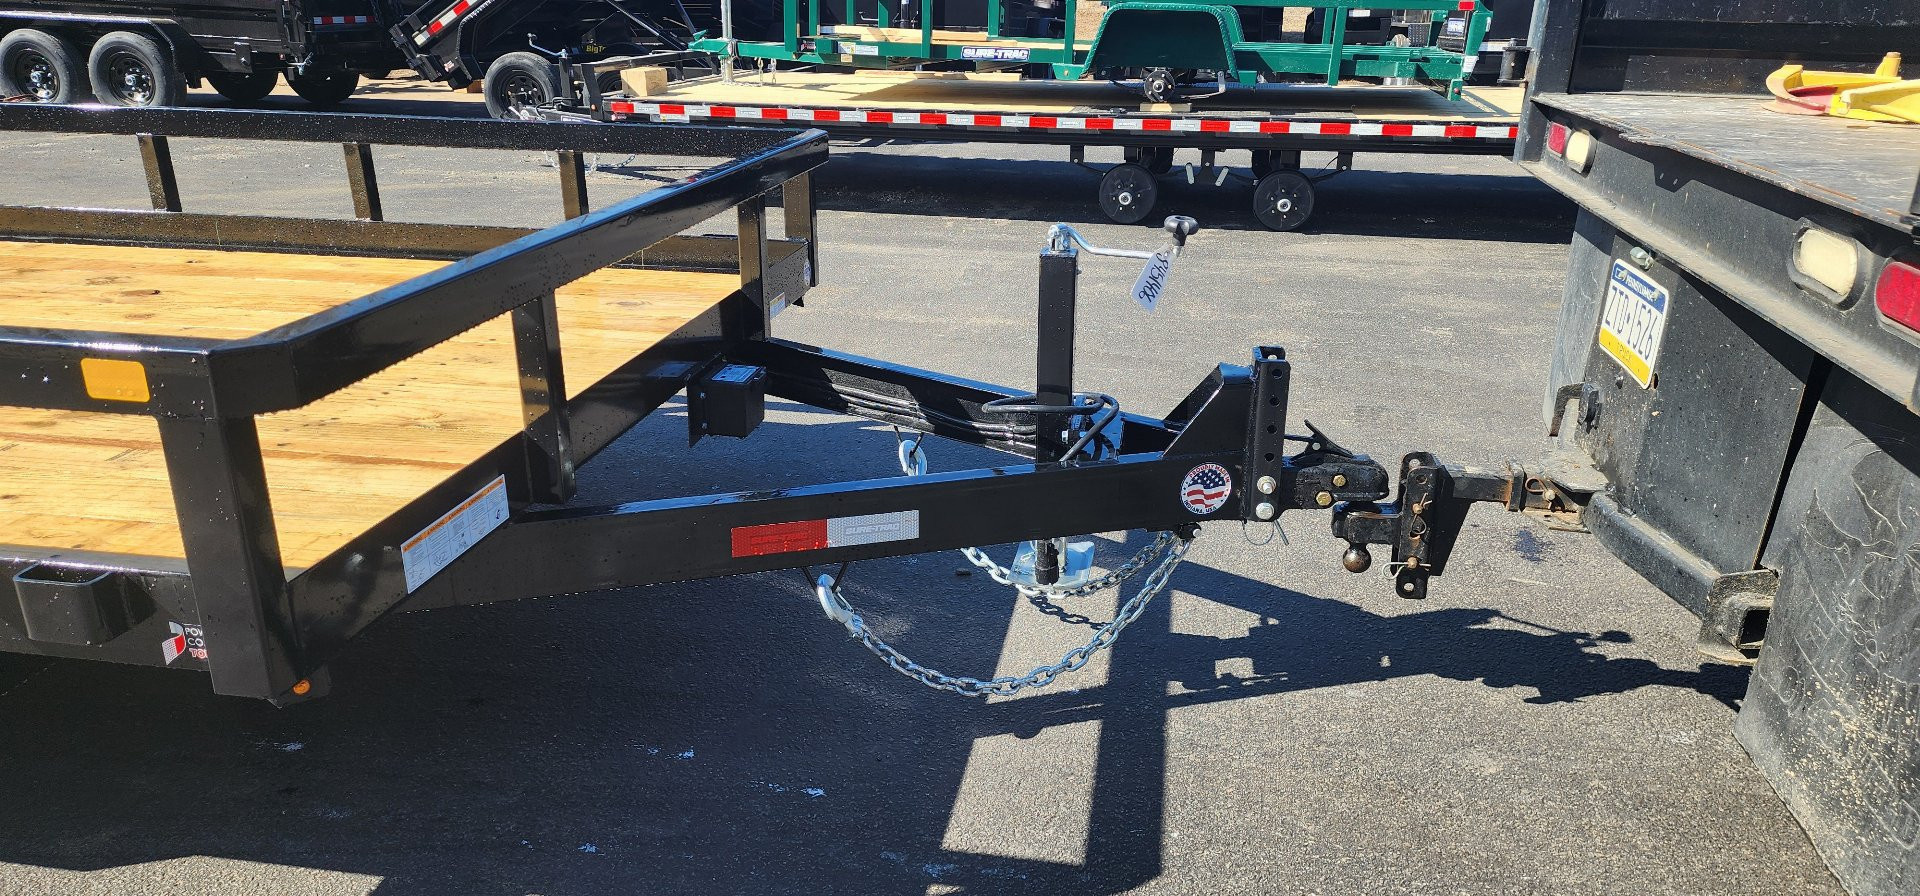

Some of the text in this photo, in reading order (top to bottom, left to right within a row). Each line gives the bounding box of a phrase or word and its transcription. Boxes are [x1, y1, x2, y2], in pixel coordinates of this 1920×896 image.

[962, 48, 1029, 60] SURE-TRAC
[1188, 464, 1215, 479] PROUDLY
[1205, 505, 1217, 514] USA
[845, 521, 901, 536] SURE-TRAC
